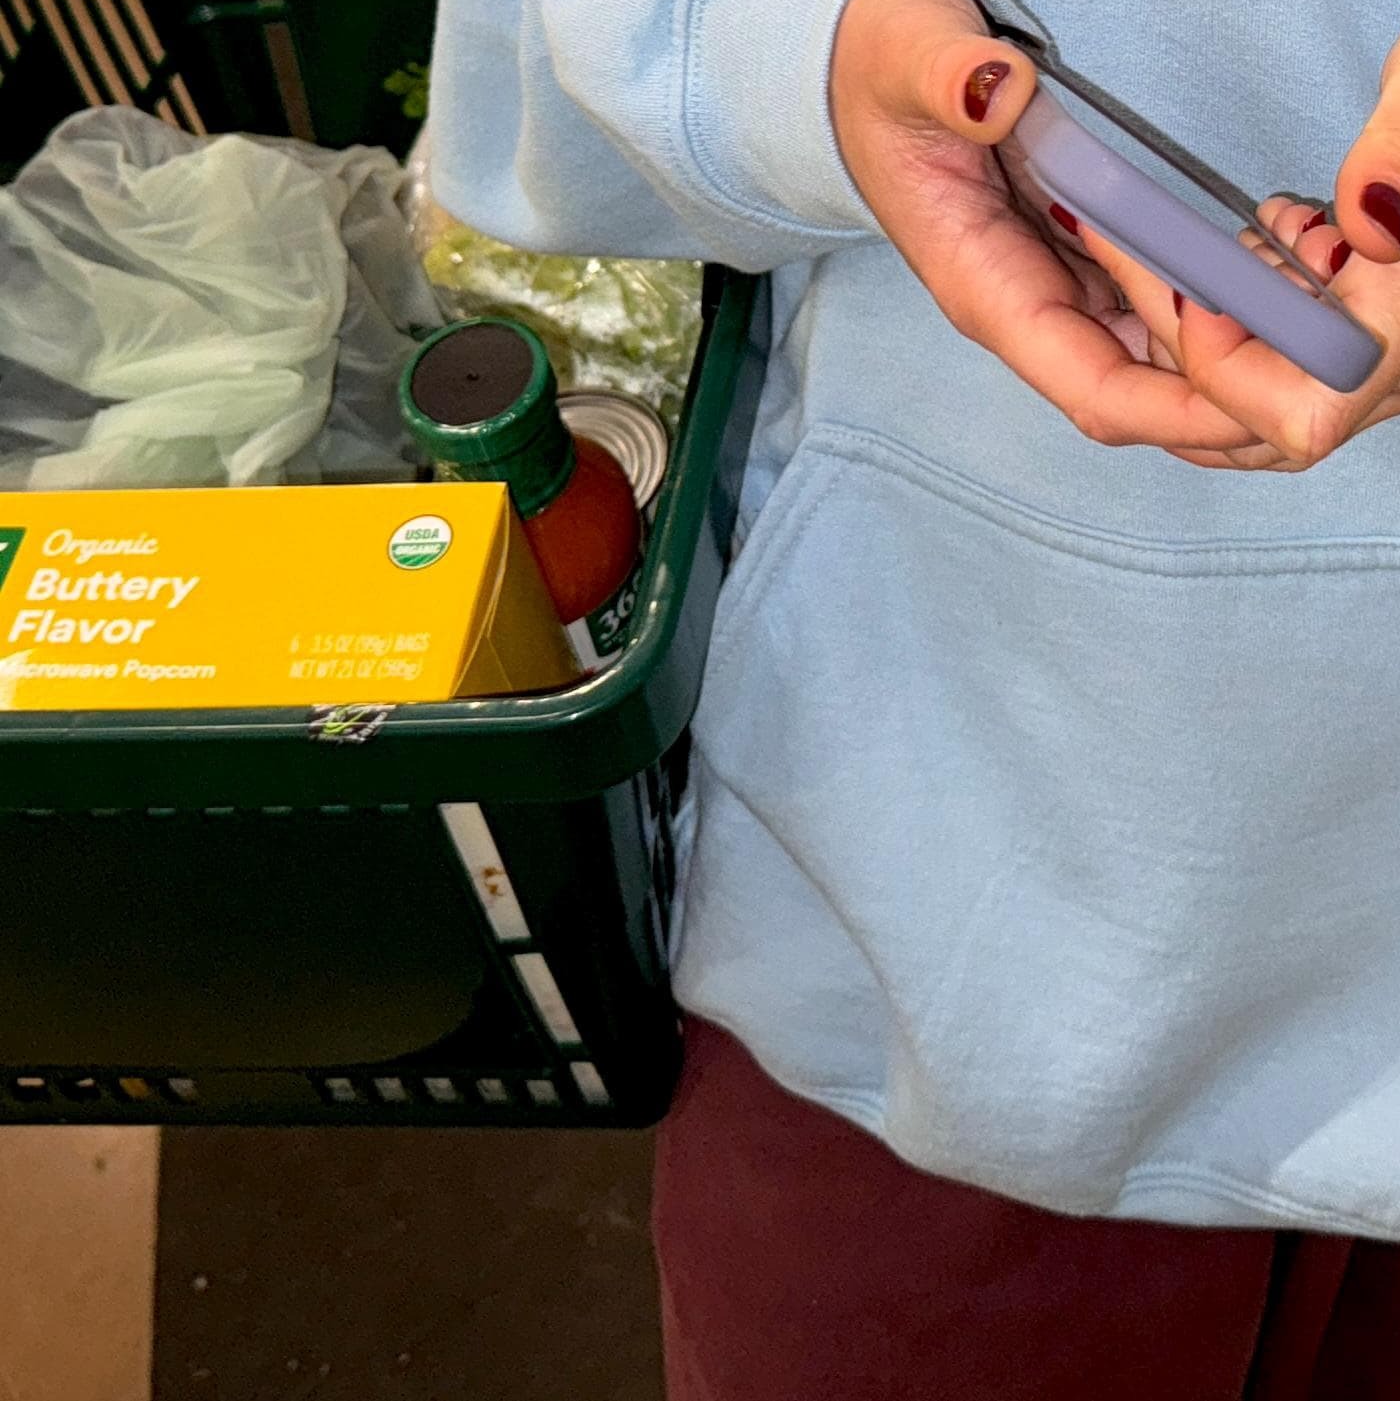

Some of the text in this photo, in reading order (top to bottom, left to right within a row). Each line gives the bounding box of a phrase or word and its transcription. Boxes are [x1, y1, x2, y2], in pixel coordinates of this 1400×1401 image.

[42, 528, 158, 564] Organic
[405, 529, 440, 540] USDA
[26, 568, 200, 609] Buttery
[7, 609, 155, 644] Flavor
[122, 659, 216, 681] Popcorn
